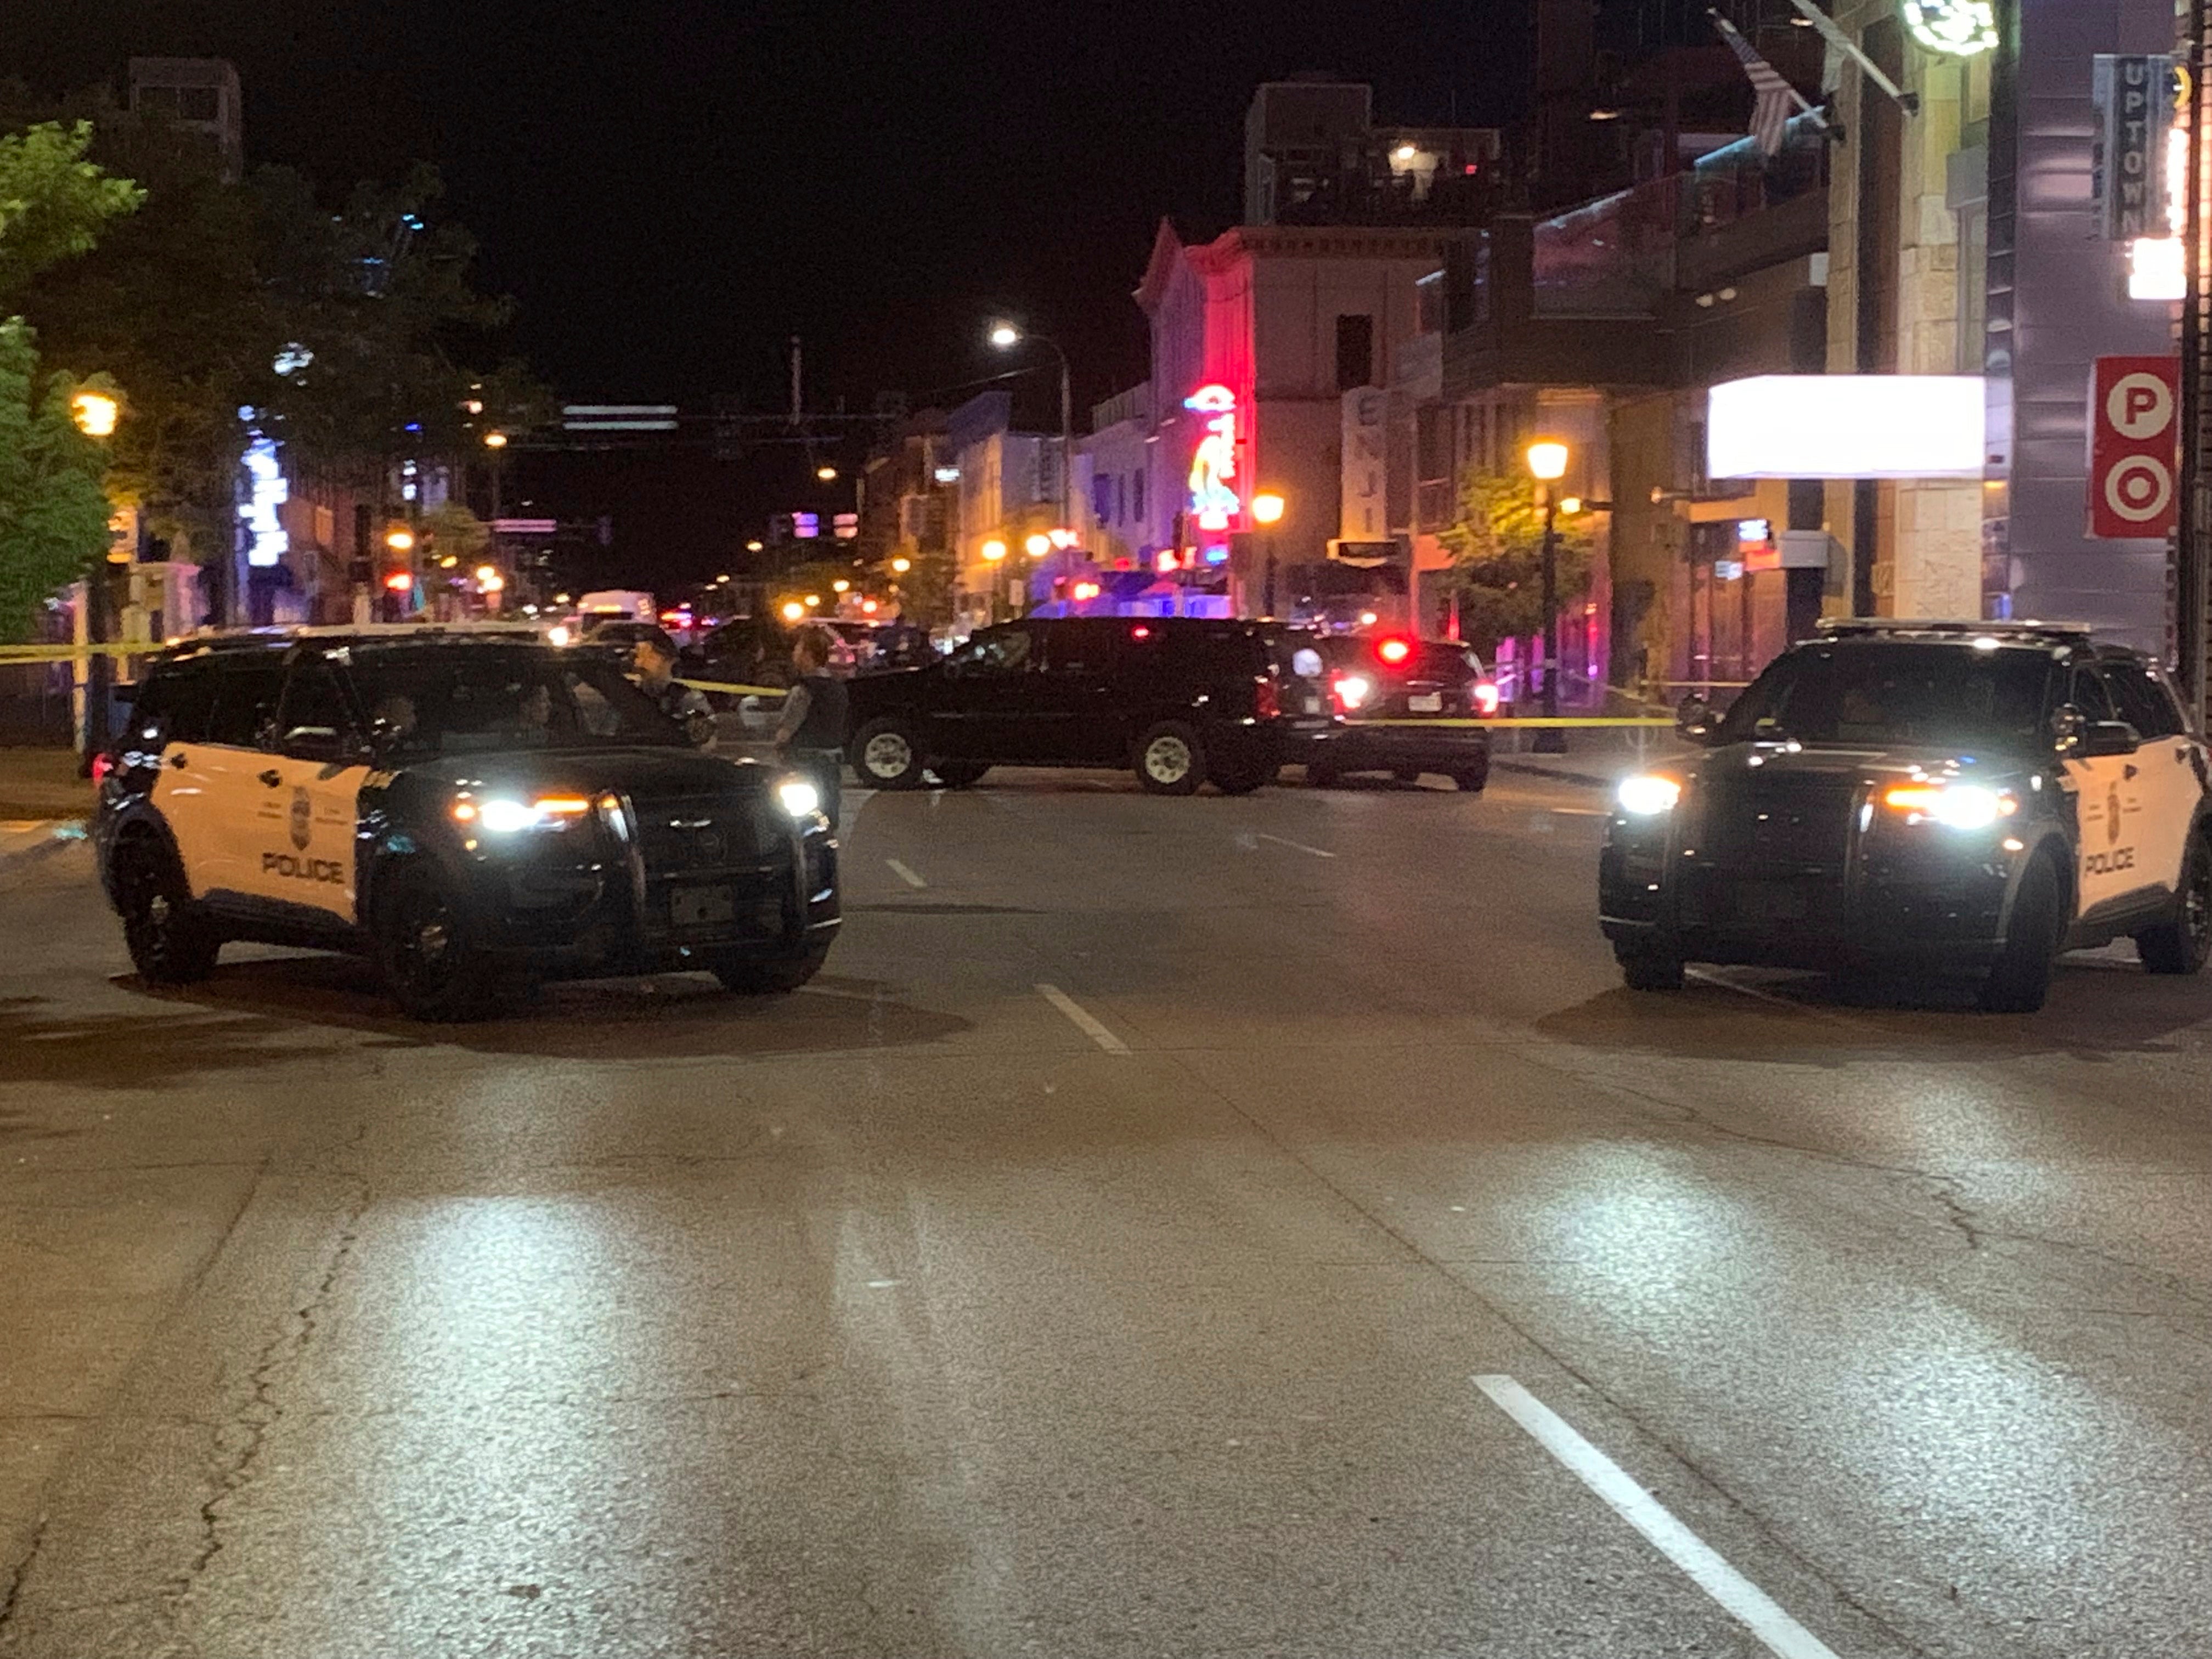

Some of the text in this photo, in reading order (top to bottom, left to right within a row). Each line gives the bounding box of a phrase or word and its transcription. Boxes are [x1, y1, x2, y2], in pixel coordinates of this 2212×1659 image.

[2121, 63, 2146, 232] UPTOWN
[2124, 387, 2157, 425] P
[262, 853, 345, 884] POLICE
[2085, 847, 2135, 877] POLICE
